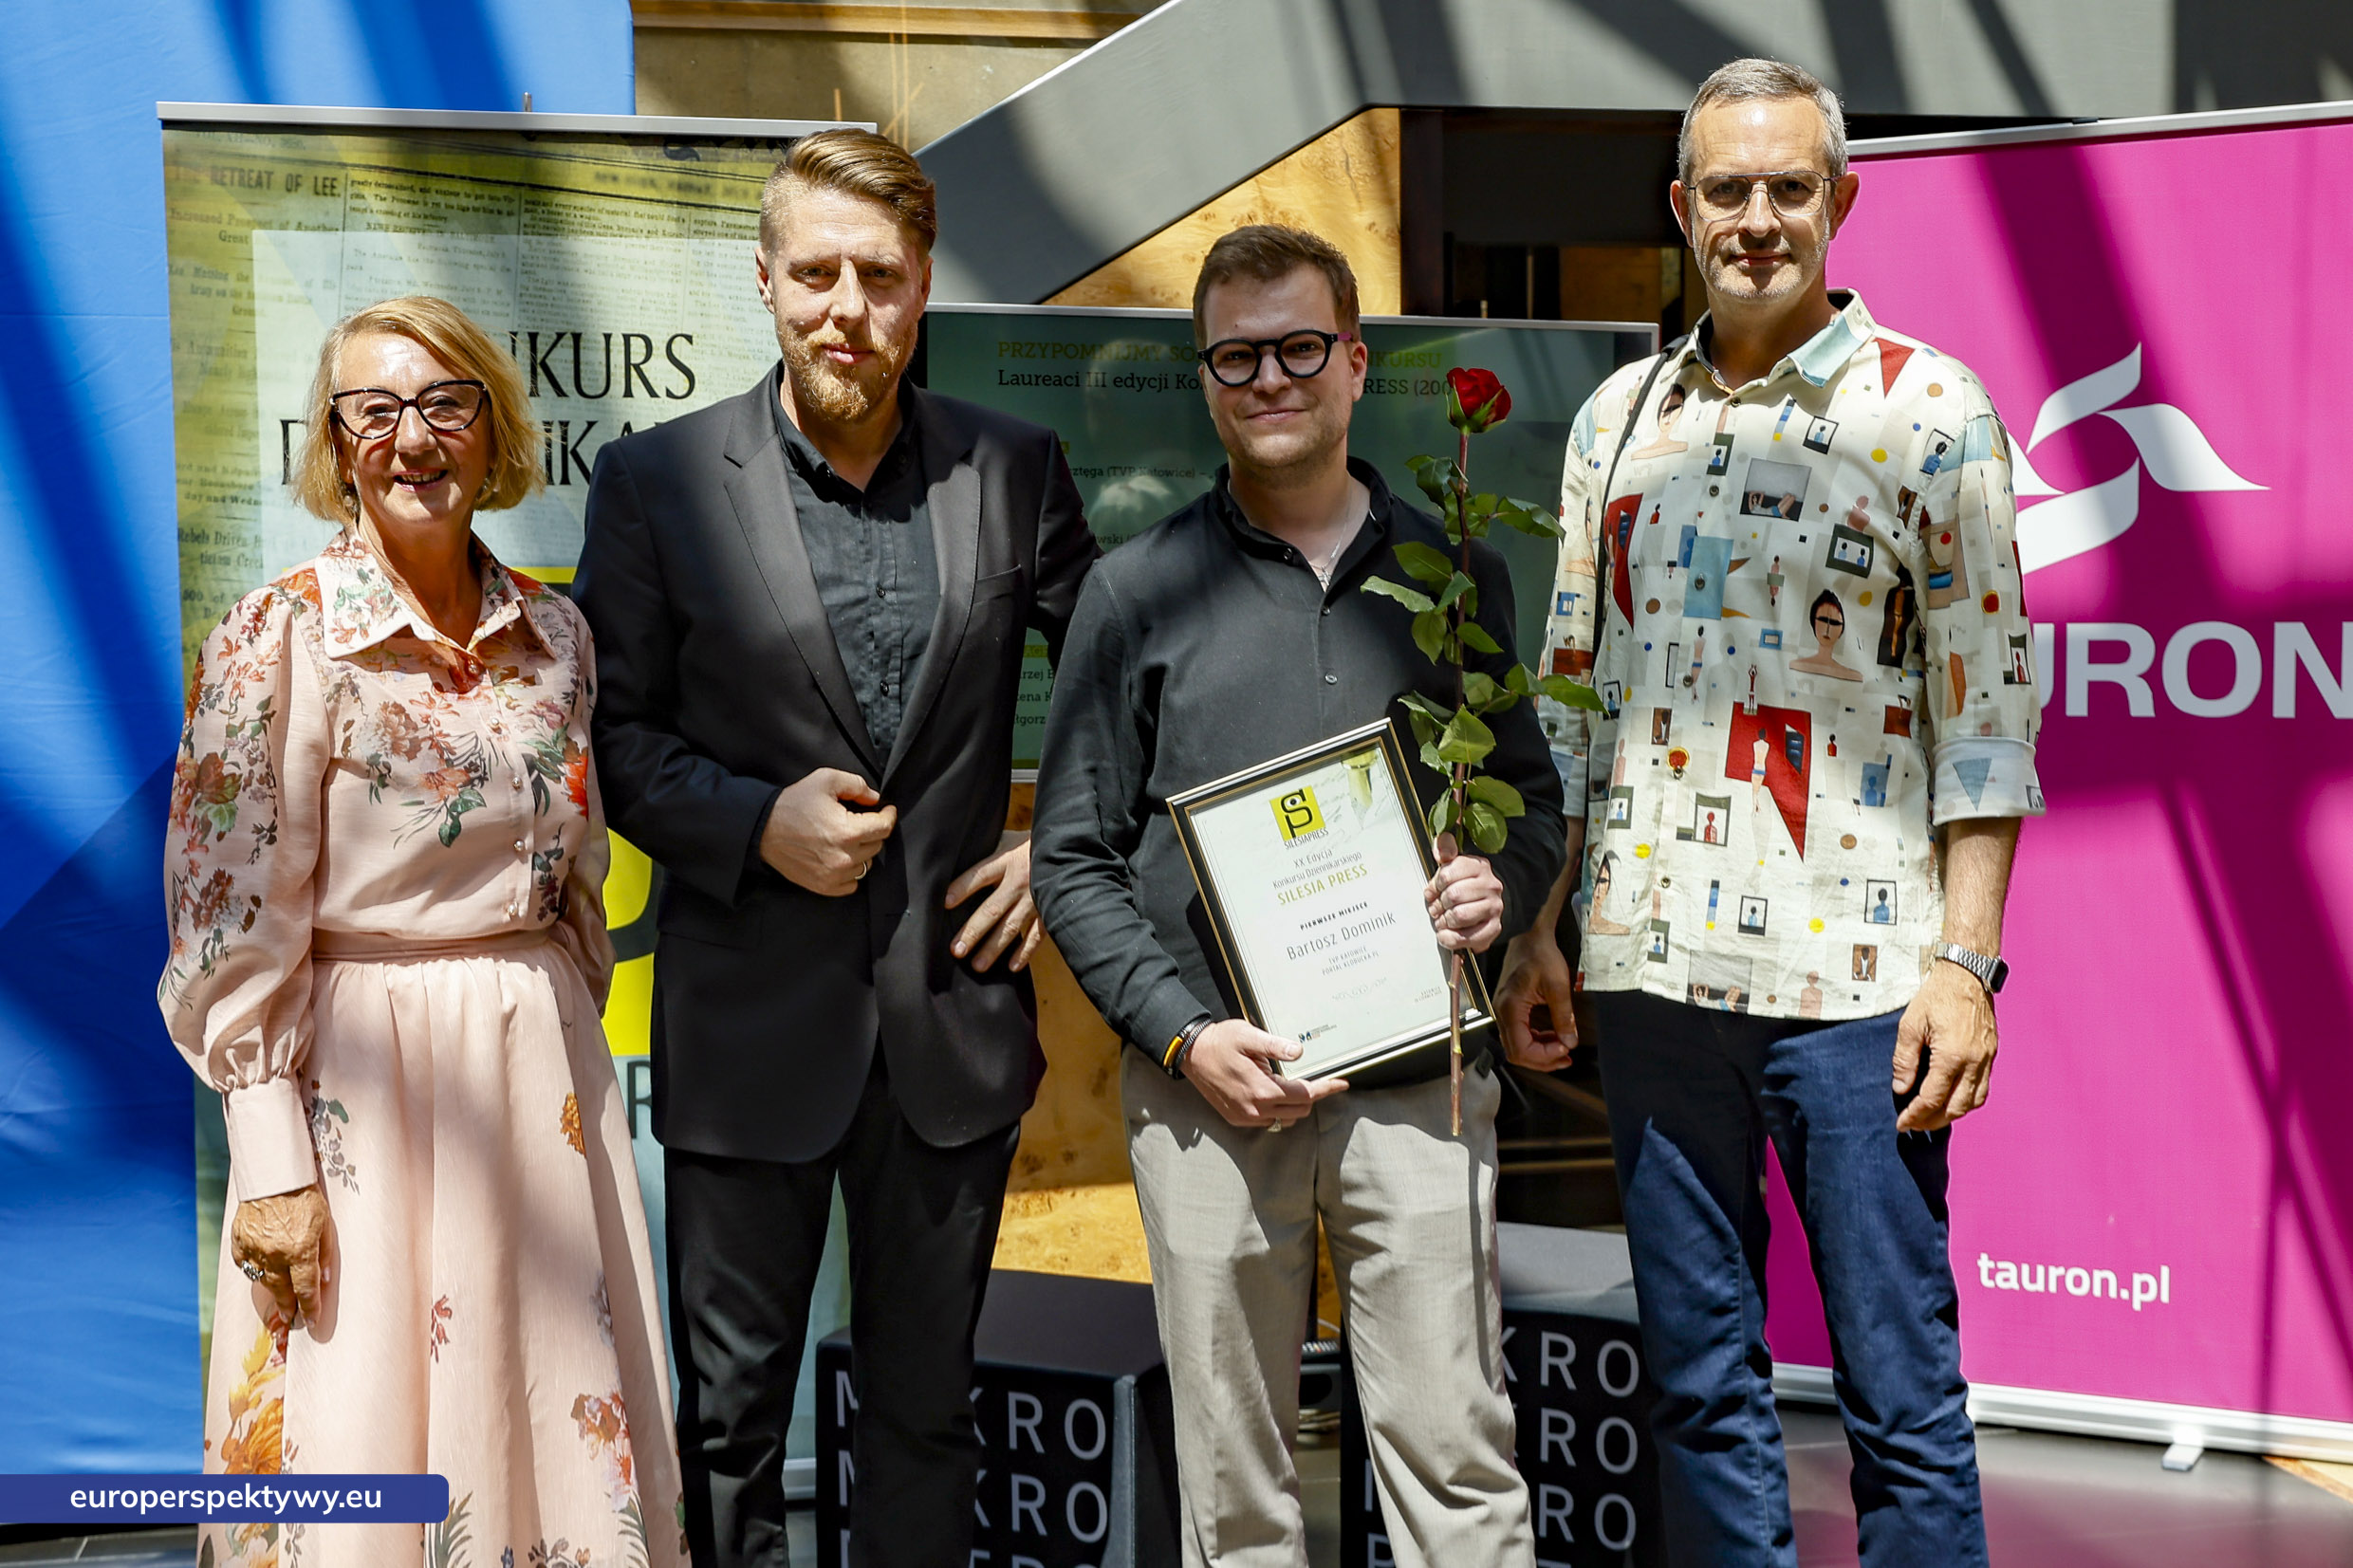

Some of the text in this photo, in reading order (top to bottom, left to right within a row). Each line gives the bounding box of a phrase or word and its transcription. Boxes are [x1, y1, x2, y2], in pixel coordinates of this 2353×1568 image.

[286, 174, 303, 193] OF
[314, 175, 342, 197] LEE.
[218, 230, 249, 245] Great
[998, 341, 1199, 363] PRZYPOMNIJMY SO
[510, 332, 695, 399] KURS
[998, 369, 1080, 388] Laureaci
[1086, 371, 1107, 388] III
[1113, 372, 1169, 392] edycji
[1285, 827, 1329, 850] SILESIAPRESS
[1293, 848, 1333, 869] XX Edycja
[1272, 872, 1306, 890] Konkursu
[1277, 863, 1368, 905] SILESIA PRESS
[1339, 901, 1368, 917] MIEJSCE
[1287, 912, 1397, 960] Bartosz Dominik
[1977, 1252, 2171, 1311] tauron.pl
